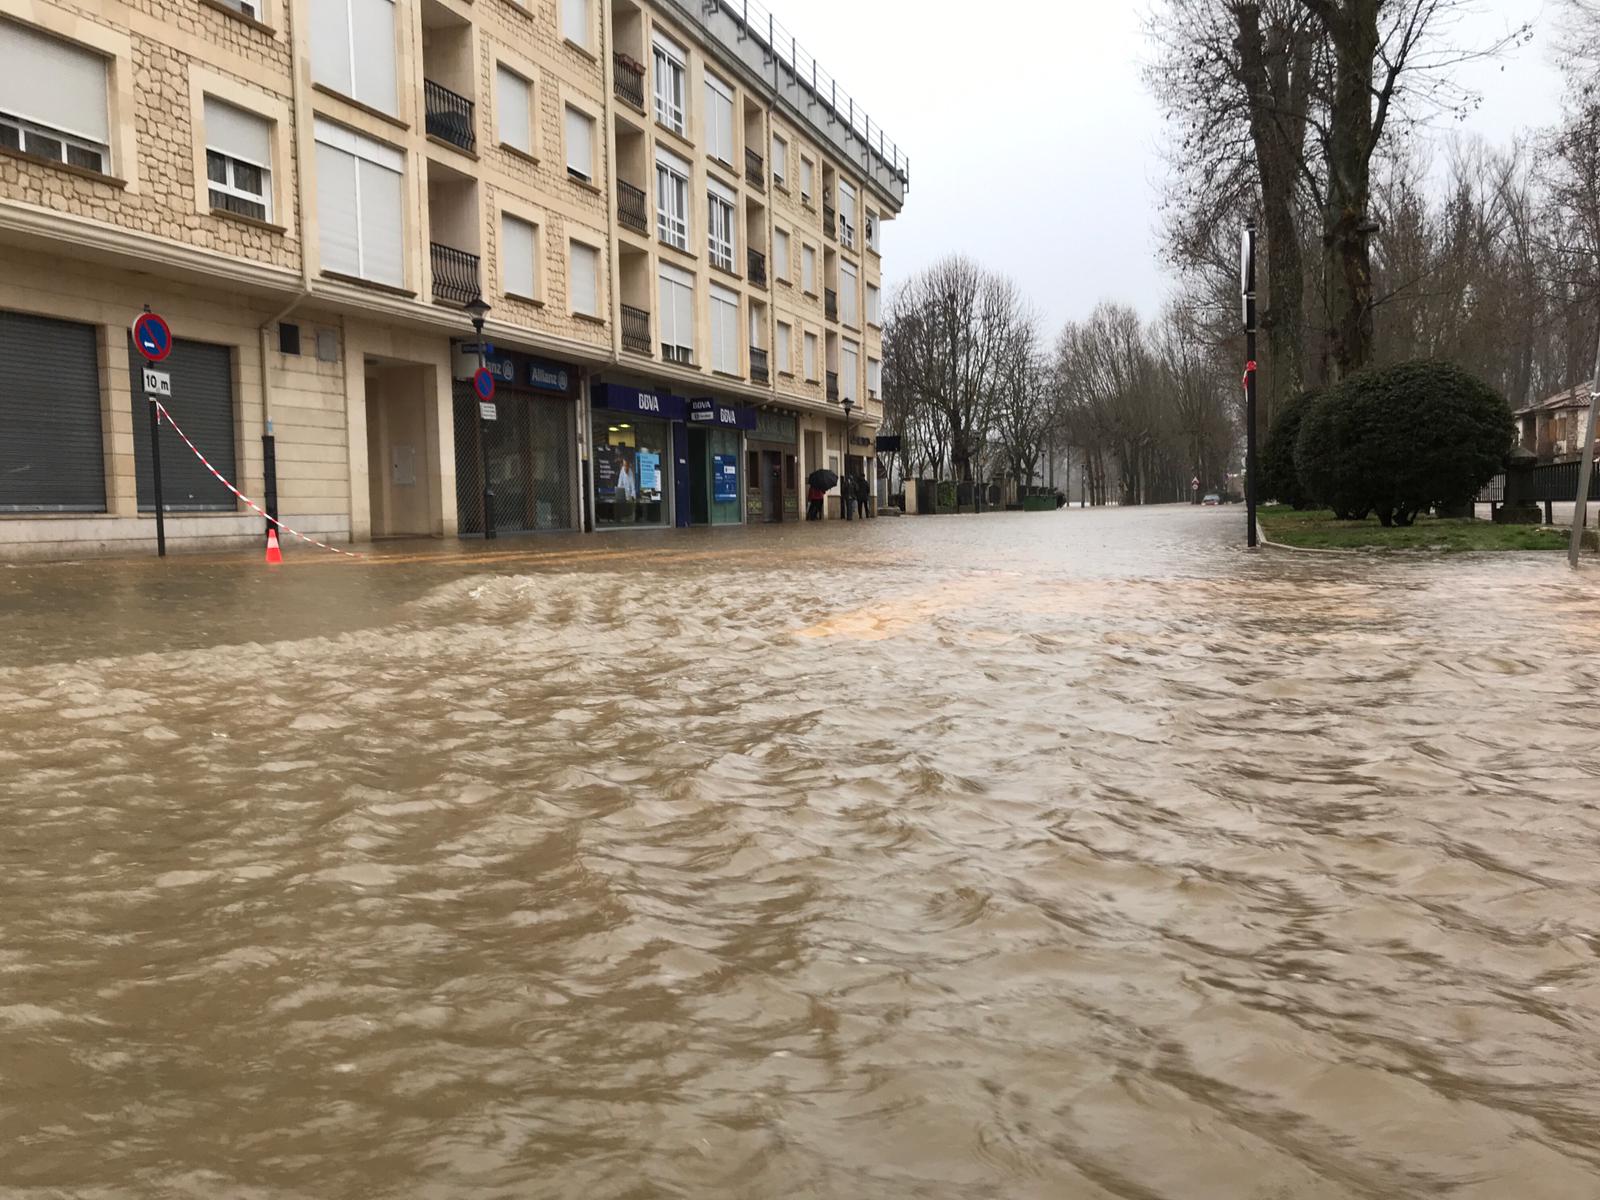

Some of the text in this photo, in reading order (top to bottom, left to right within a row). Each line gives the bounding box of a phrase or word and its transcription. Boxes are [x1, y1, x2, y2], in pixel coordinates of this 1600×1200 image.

[146, 375, 169, 390] 10 m
[531, 367, 558, 385] Allianz
[638, 393, 659, 411] BBVA
[692, 401, 711, 409] BBVA
[720, 408, 736, 424] BBVA
